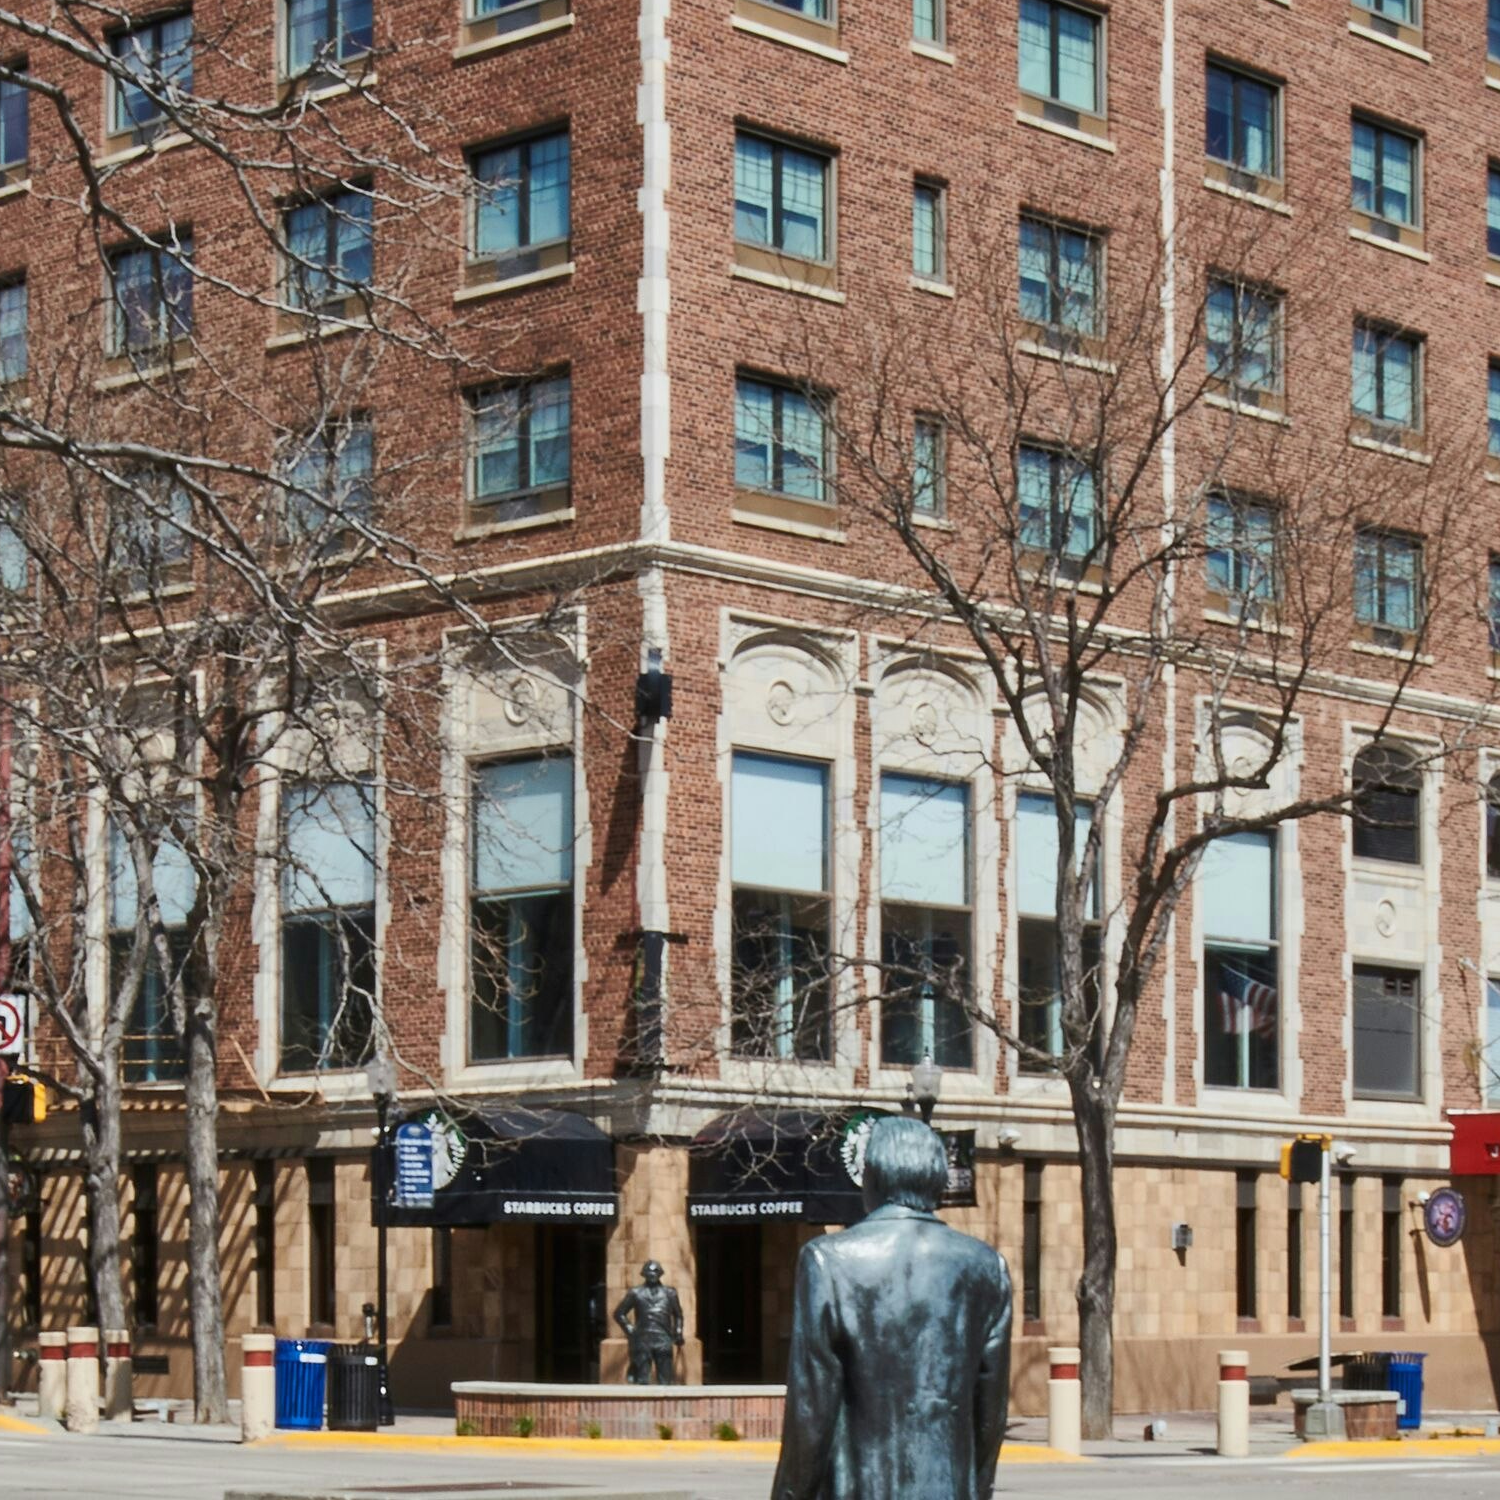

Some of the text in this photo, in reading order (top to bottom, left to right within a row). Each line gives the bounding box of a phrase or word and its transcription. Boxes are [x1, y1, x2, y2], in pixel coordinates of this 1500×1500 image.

[504, 1201, 615, 1216] STARBUCKS COFFEE
[691, 1201, 803, 1216] STARBUCKS COFFEE
